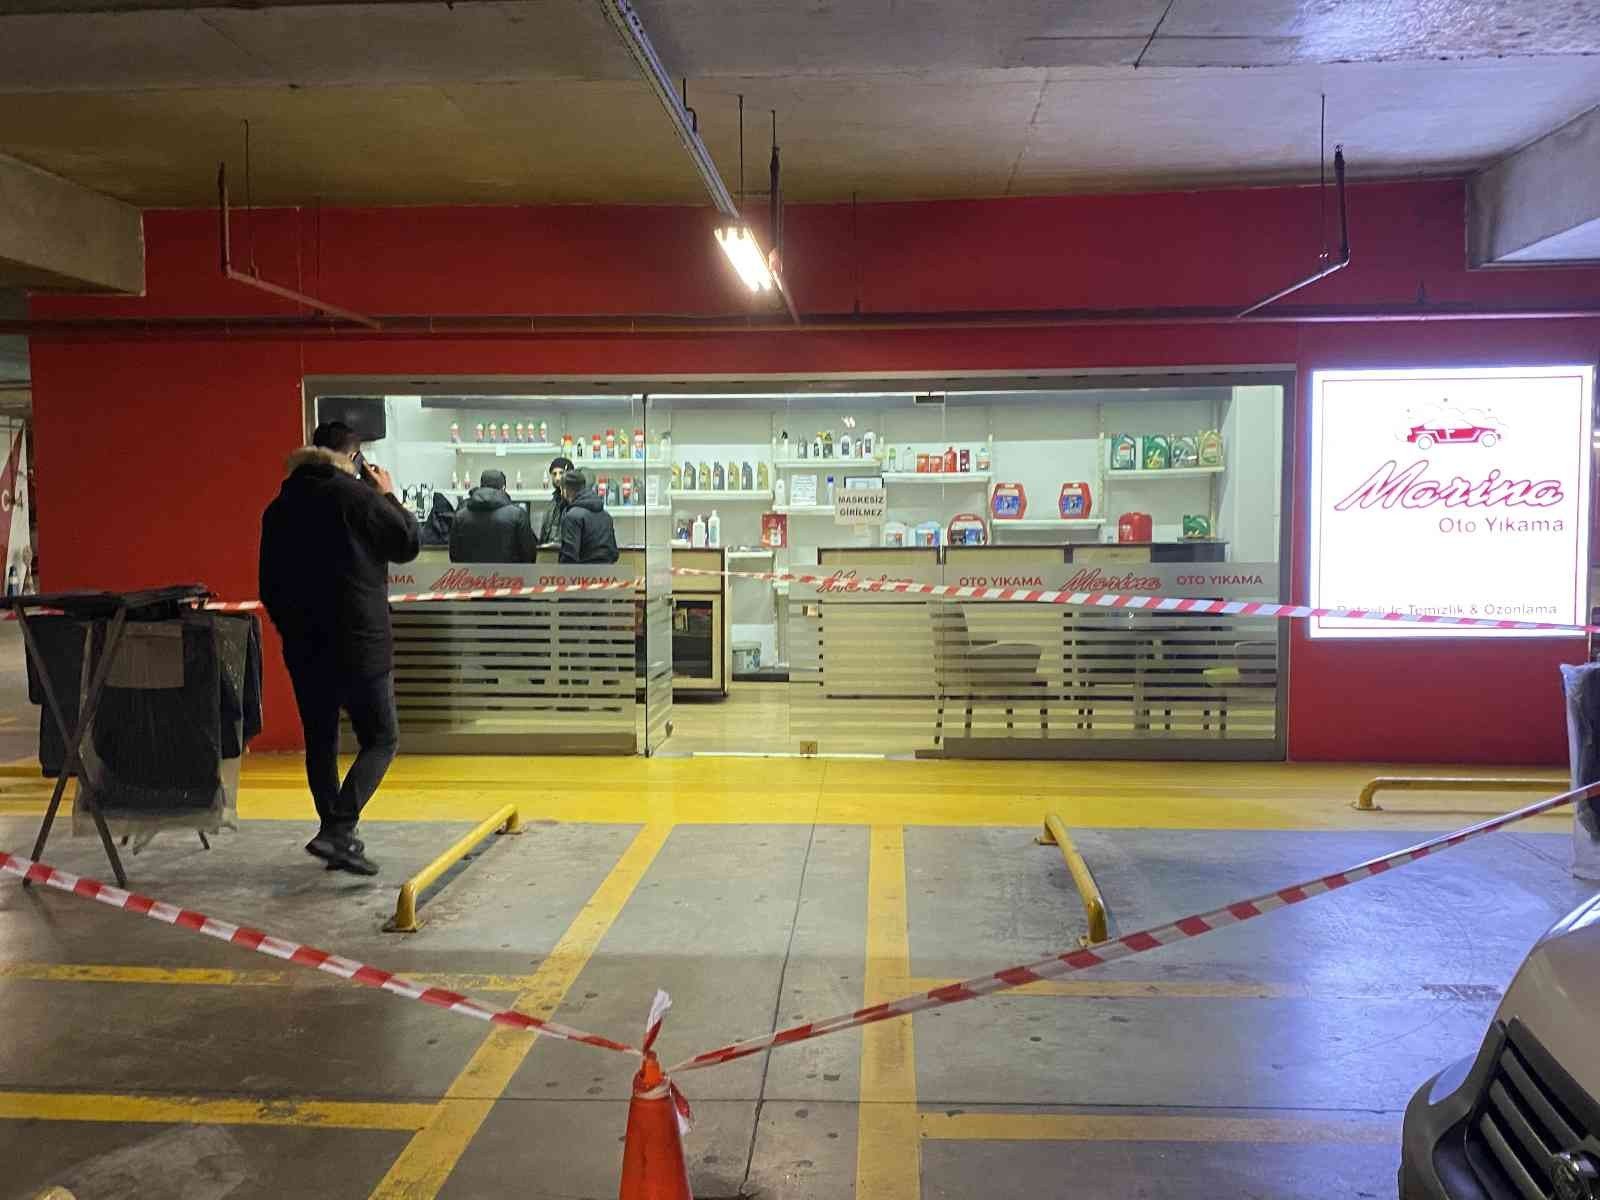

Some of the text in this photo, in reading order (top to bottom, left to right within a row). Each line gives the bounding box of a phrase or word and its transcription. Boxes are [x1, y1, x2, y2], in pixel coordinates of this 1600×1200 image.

[1334, 460, 1565, 512] Marina
[1438, 516, 1477, 534] Oto
[539, 575, 566, 586] OTO
[959, 567, 1264, 592] OTO YIKAMA Marina OTO YIKAMA
